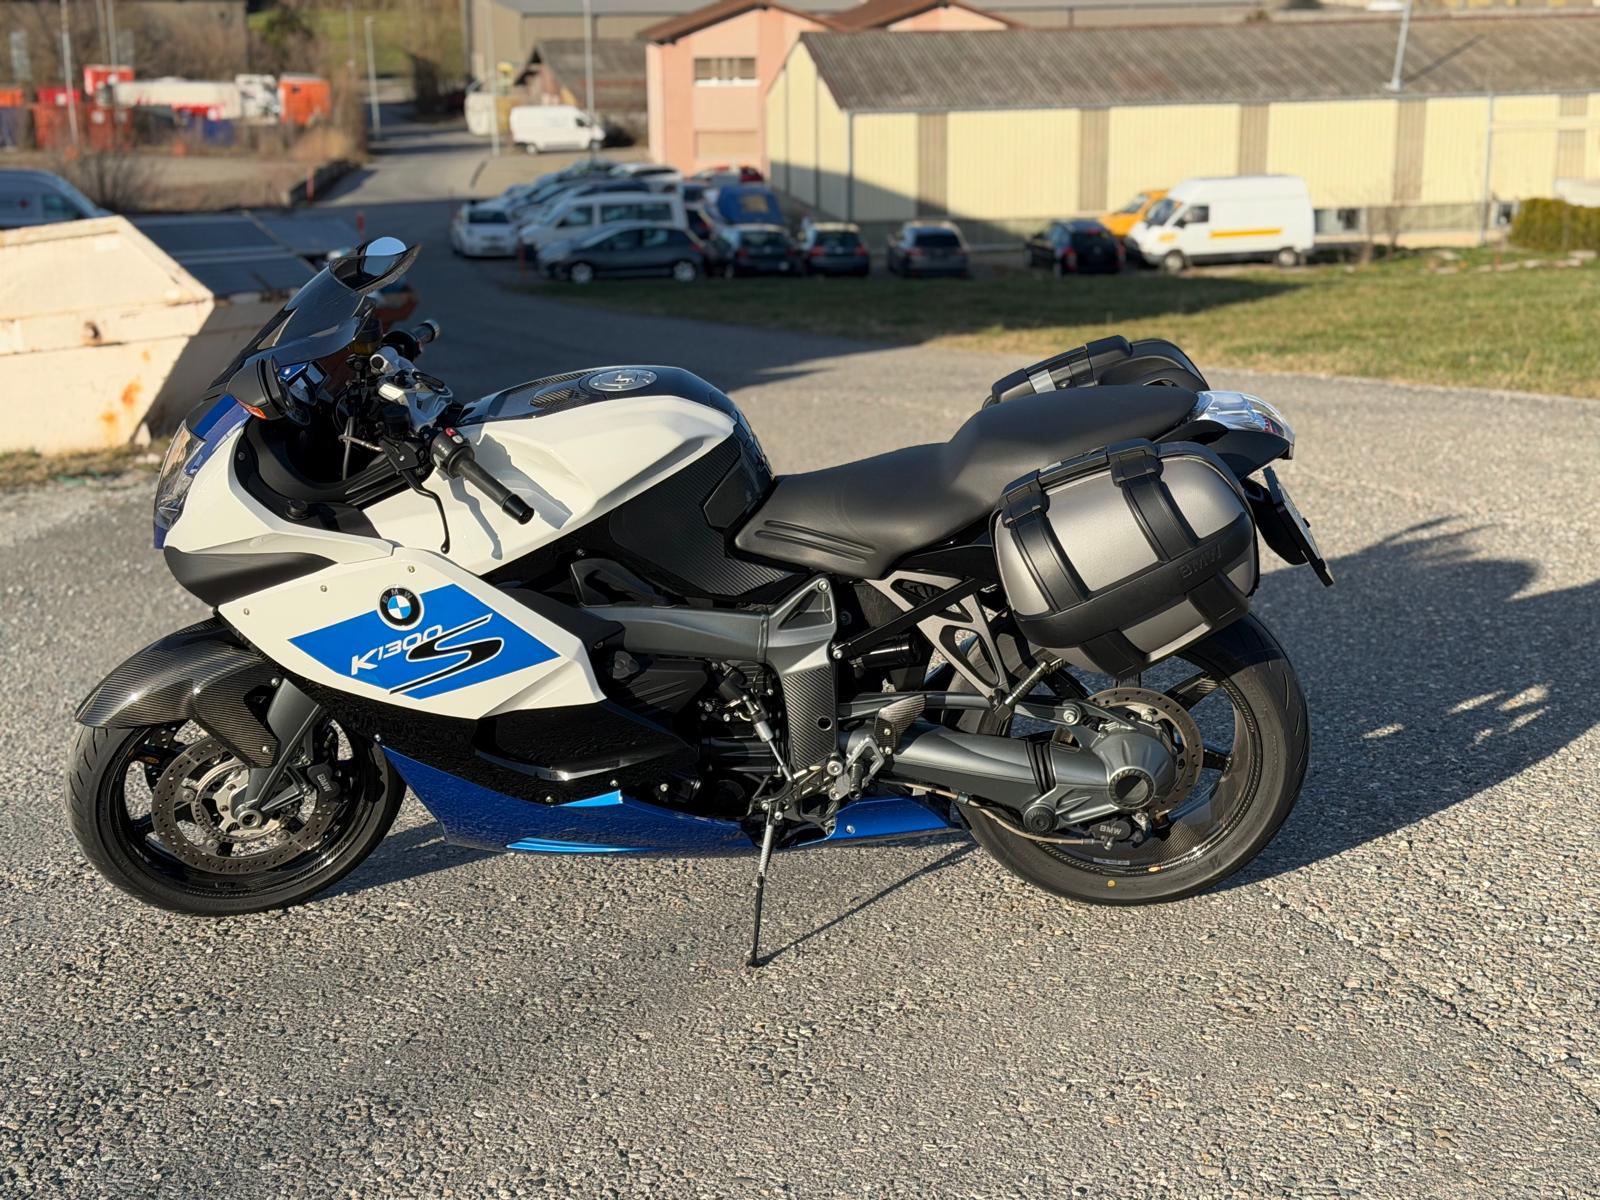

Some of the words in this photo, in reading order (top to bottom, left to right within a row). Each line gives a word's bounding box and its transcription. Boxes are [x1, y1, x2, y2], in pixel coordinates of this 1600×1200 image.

[382, 588, 412, 603] BMW
[317, 773, 332, 791] BMW
[1100, 825, 1121, 835] BMW
